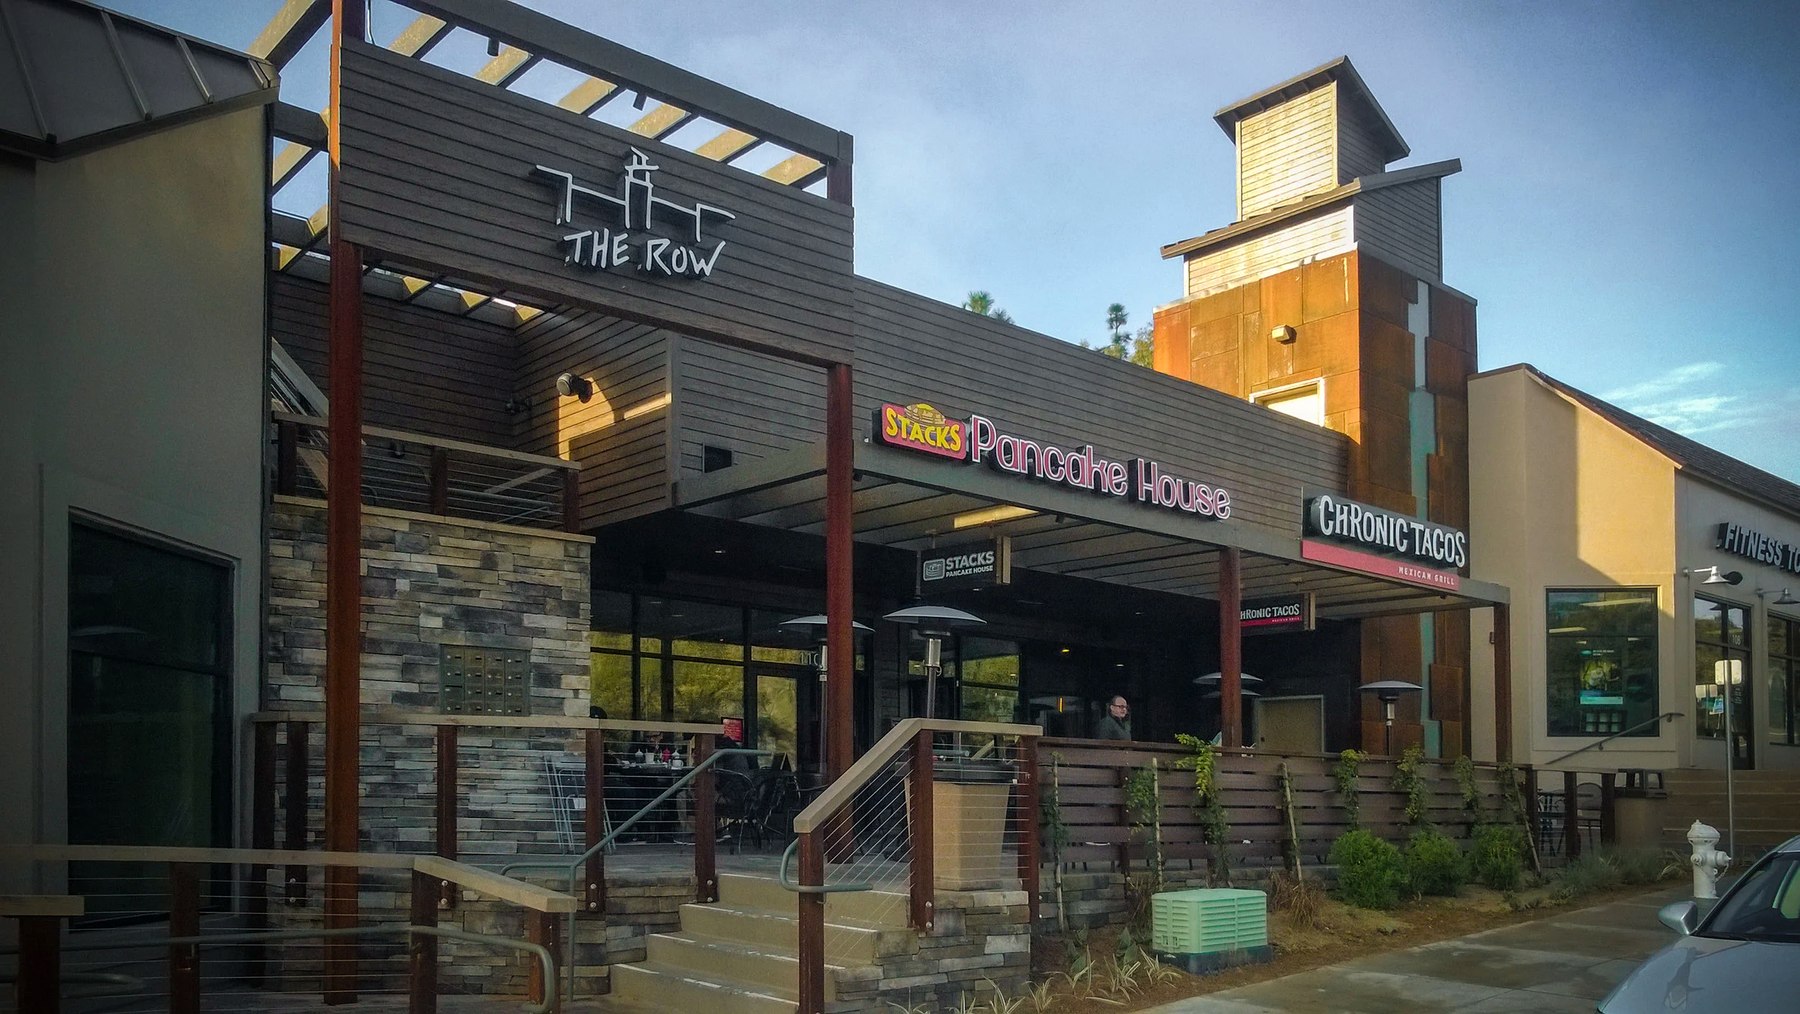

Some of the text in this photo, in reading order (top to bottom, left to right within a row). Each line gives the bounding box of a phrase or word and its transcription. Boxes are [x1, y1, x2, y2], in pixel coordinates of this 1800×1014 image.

[563, 228, 726, 277] THE ROW
[885, 407, 962, 452] STACKS
[971, 414, 1231, 520] Pancake House
[1319, 494, 1466, 568] CHRONIC TACOS
[1724, 522, 1783, 566] FITNESS
[946, 551, 994, 570] STACKS
[946, 565, 993, 578] PANCAKE HOUSE
[1398, 565, 1455, 586] MEXICAN GRILL
[1240, 607, 1271, 620] HRONIC
[1272, 603, 1300, 617] TACOS
